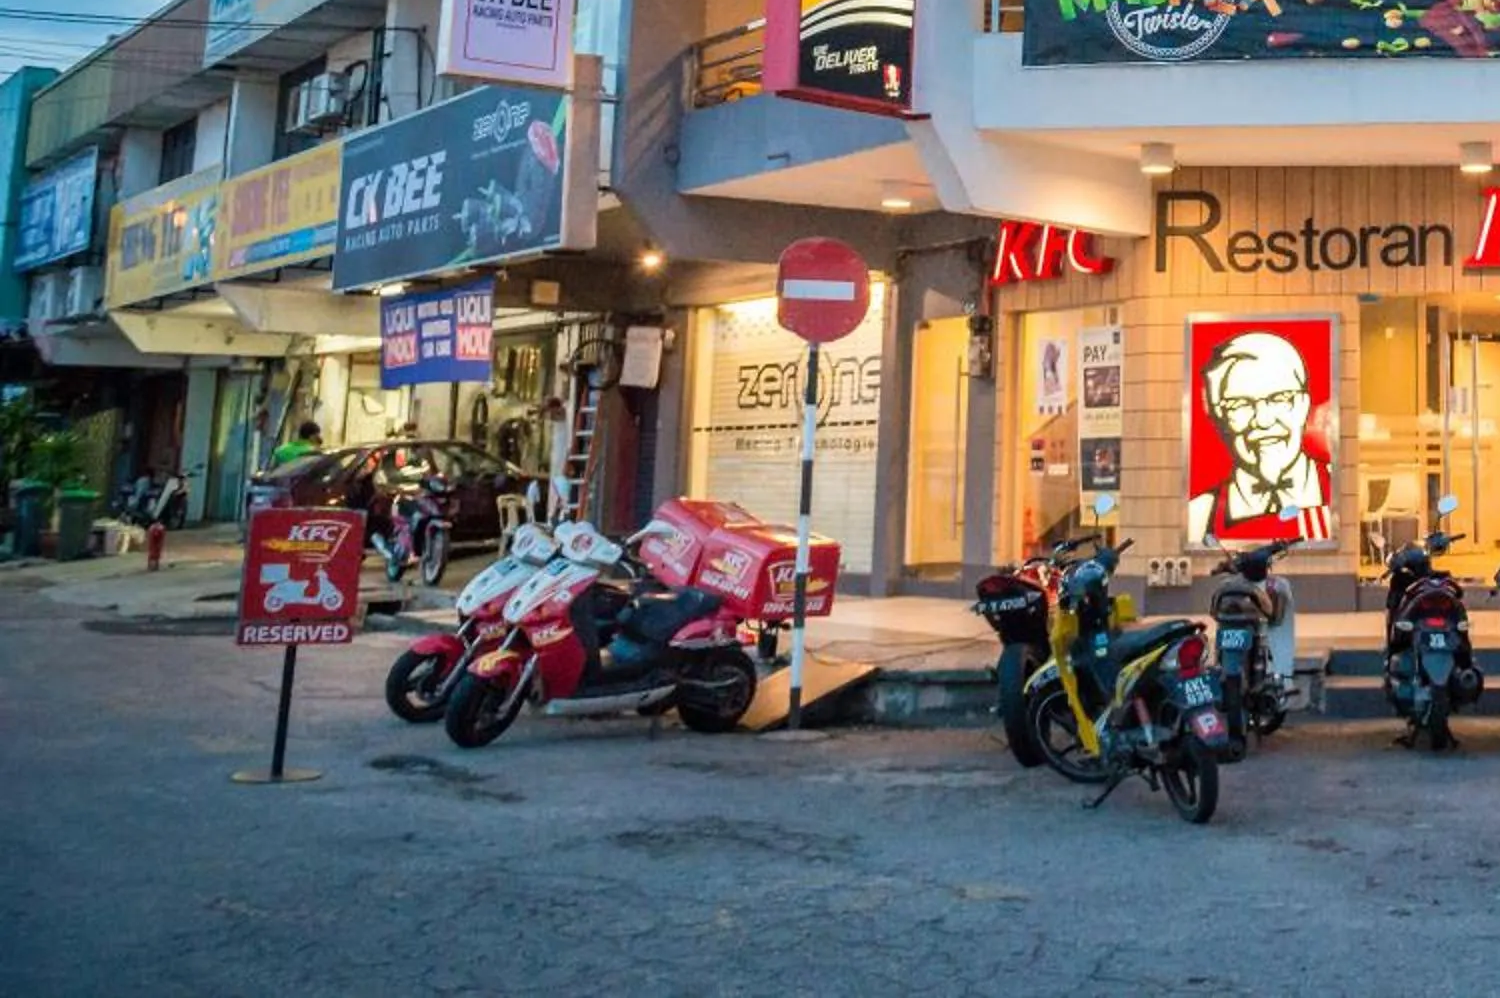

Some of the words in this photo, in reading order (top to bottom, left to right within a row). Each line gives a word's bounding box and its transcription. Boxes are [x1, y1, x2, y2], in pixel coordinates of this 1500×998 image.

[346, 170, 384, 230] CK
[383, 150, 448, 220] BEE
[407, 213, 440, 238] PARTS
[1155, 191, 1452, 273] Restoran
[457, 326, 492, 357] MOLY
[1083, 346, 1107, 362] PAY
[288, 525, 339, 541] KFC
[243, 624, 348, 643] RESERVED
